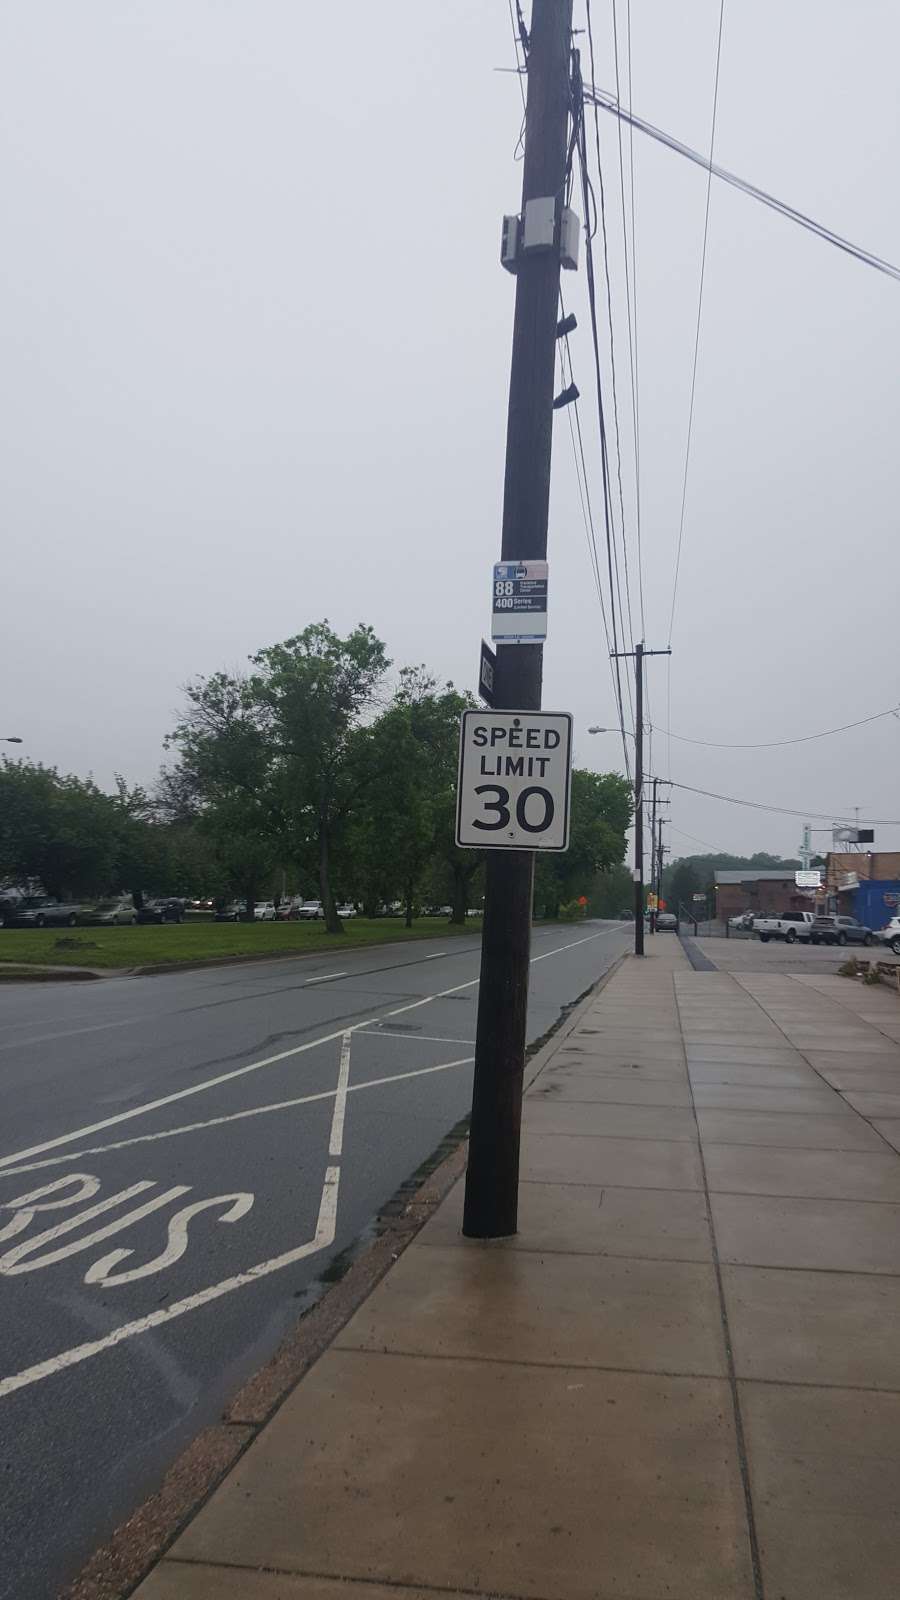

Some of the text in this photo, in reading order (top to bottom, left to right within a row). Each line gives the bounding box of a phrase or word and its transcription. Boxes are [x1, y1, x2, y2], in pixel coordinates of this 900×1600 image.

[495, 581, 513, 596] 88
[495, 598, 513, 609] 400
[472, 726, 561, 749] SPEED
[480, 755, 550, 777] LIMIT
[471, 784, 555, 833] 30
